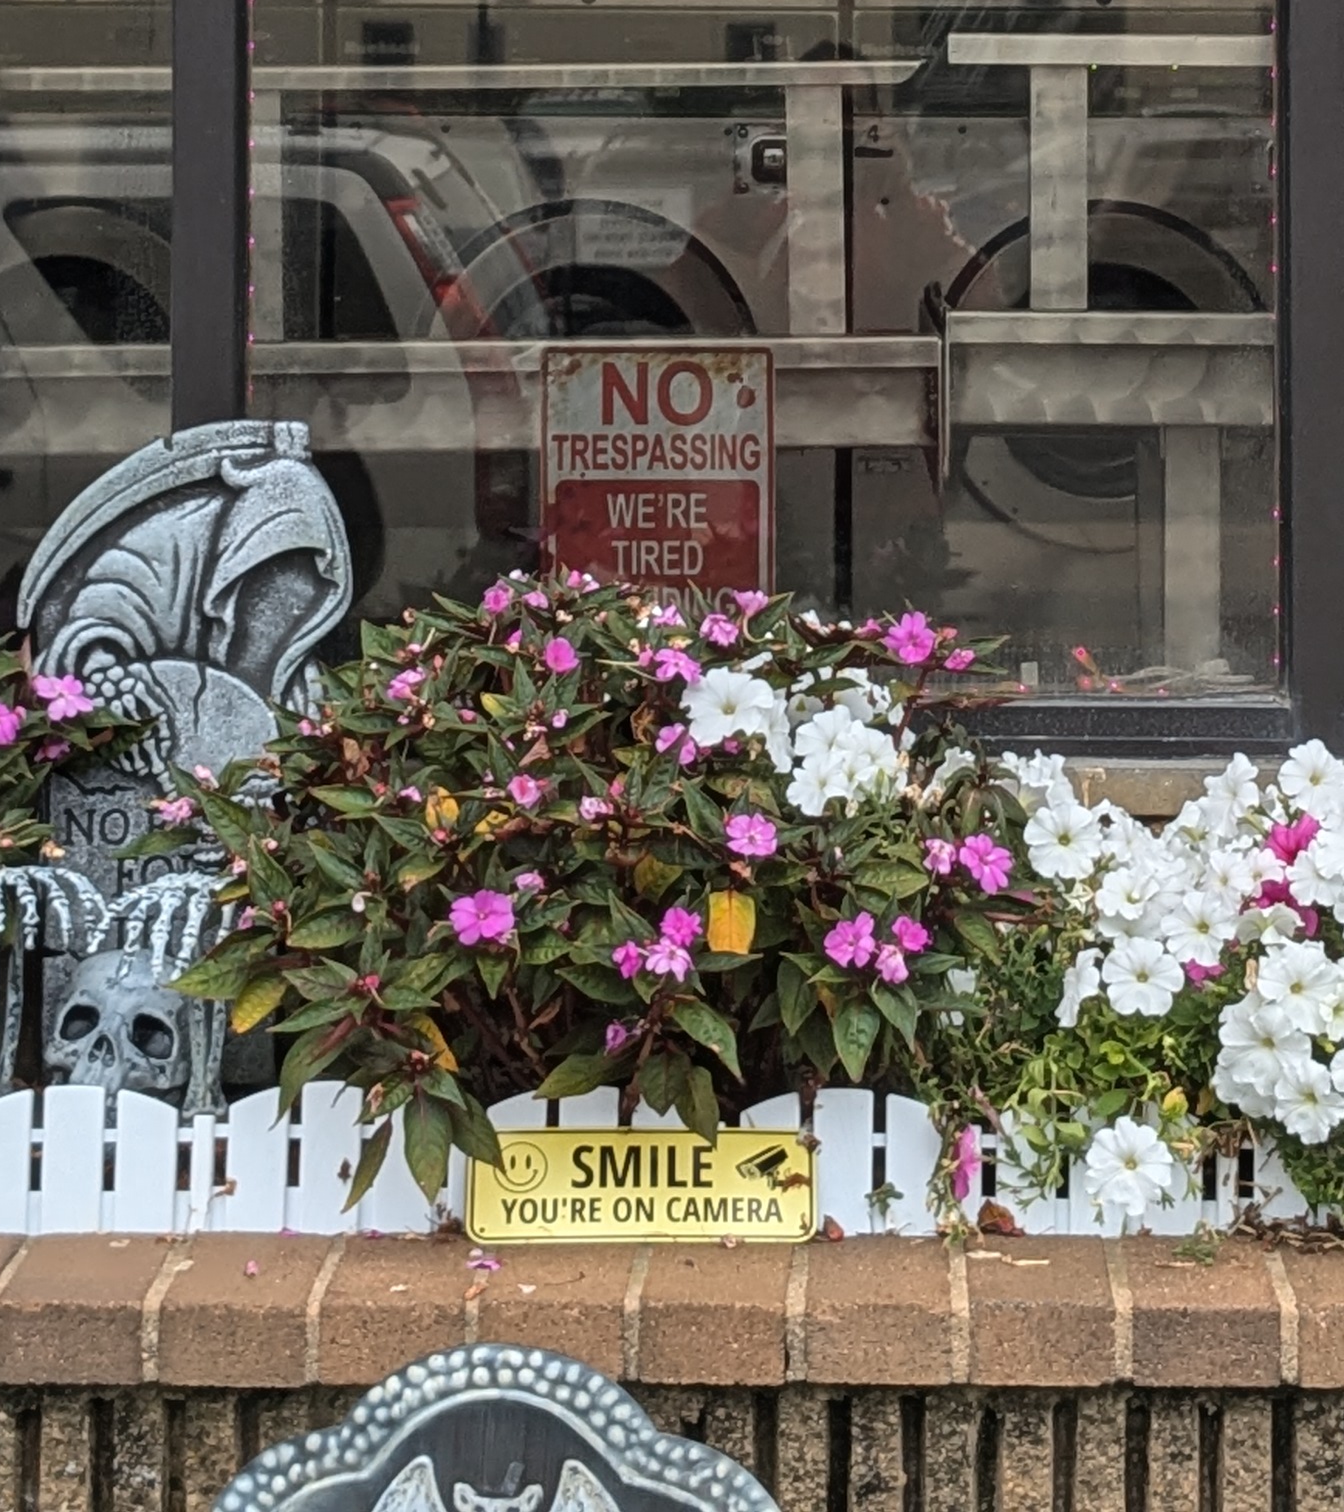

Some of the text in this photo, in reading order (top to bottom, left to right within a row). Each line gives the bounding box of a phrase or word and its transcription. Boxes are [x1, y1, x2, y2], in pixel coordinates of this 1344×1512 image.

[867, 124, 880, 143] 4
[601, 360, 713, 426] NO
[551, 433, 761, 471] TRESPASSING
[607, 493, 708, 529] WE'RE
[611, 539, 704, 576] TIRED
[63, 808, 130, 846] NO
[570, 1145, 714, 1189] SMILE
[501, 1196, 784, 1224] YOU'RE ON CAMERA
